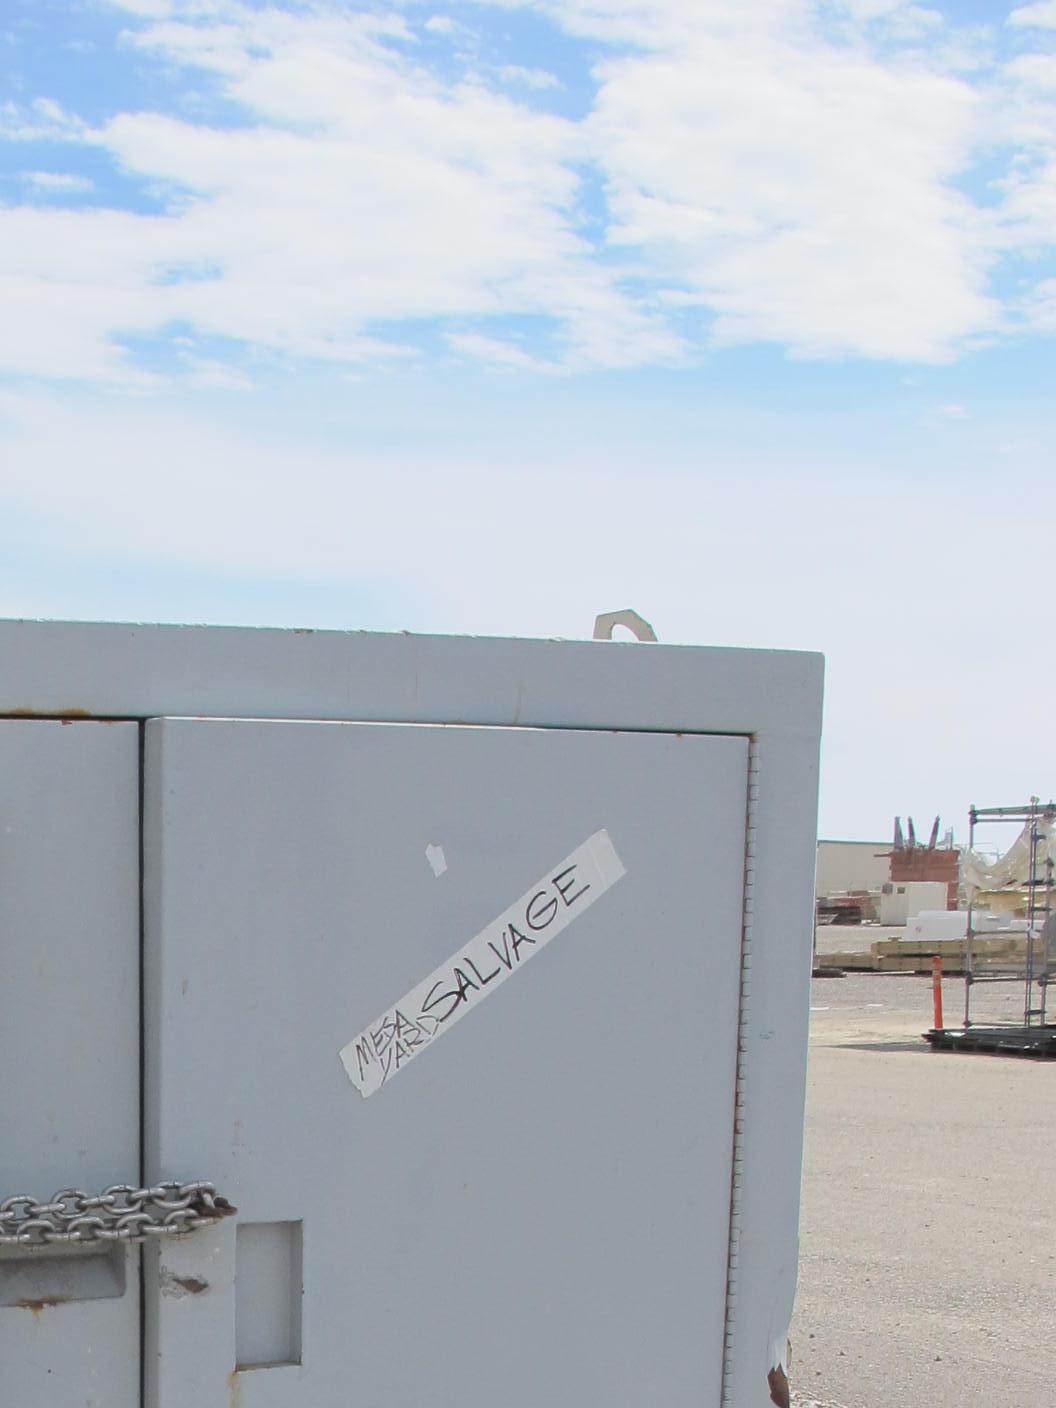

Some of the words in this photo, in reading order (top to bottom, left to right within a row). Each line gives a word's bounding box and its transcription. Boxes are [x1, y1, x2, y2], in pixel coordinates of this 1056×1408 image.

[421, 864, 591, 1023] SALVAGE
[355, 1010, 416, 1081] MESA
[380, 1015, 440, 1087] YARD
